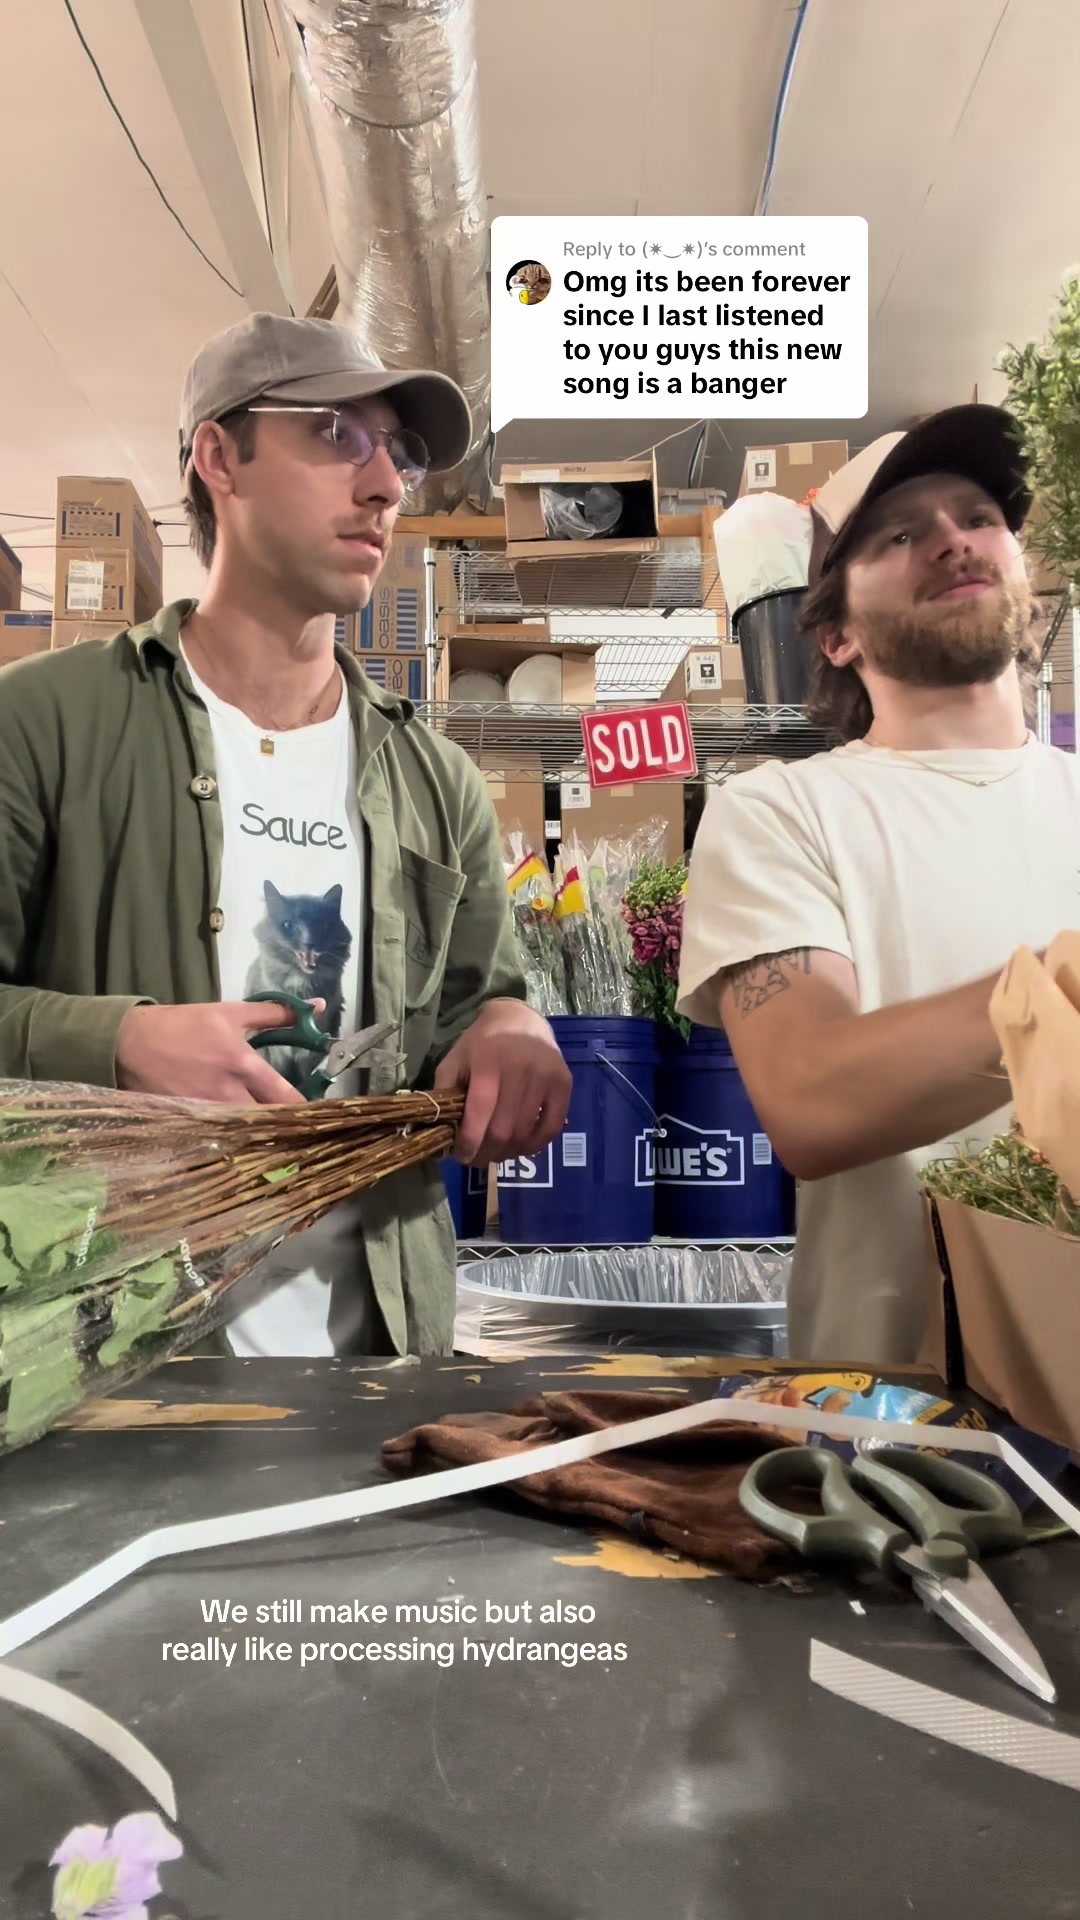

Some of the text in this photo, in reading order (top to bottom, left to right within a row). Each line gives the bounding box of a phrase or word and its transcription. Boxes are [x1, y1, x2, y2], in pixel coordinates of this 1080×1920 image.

[379, 587, 390, 649] oasis
[591, 714, 685, 773] SOLD
[240, 803, 347, 850] Sauce
